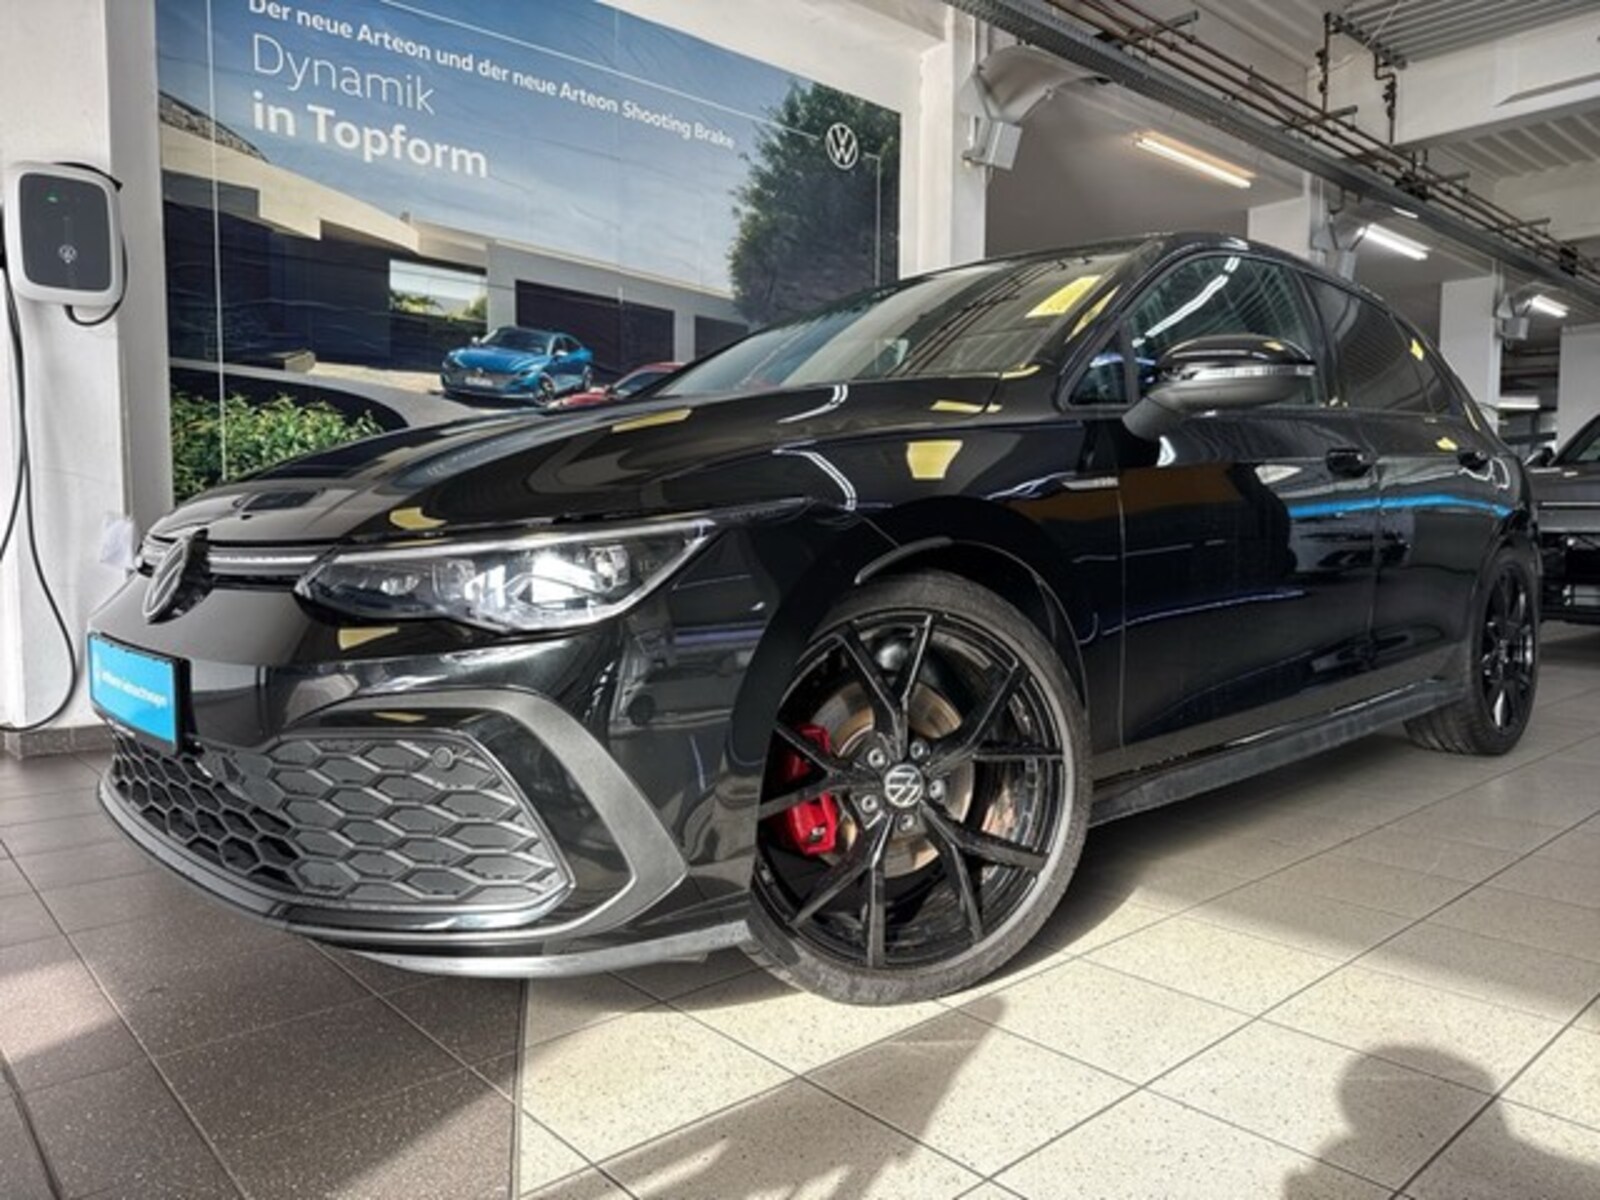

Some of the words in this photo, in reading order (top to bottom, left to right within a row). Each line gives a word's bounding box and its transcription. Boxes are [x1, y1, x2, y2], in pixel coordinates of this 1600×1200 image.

[249, 0, 292, 21] Der
[296, 9, 353, 39] neue
[357, 24, 432, 61] Arteon
[435, 49, 474, 72] und
[477, 59, 510, 82] der
[513, 71, 556, 96] neue
[559, 82, 618, 113] Arteon
[622, 99, 691, 141] Shooting
[694, 123, 736, 149] Brake
[253, 33, 435, 115] Dynamik
[253, 90, 296, 137] in
[307, 104, 487, 178] Topform
